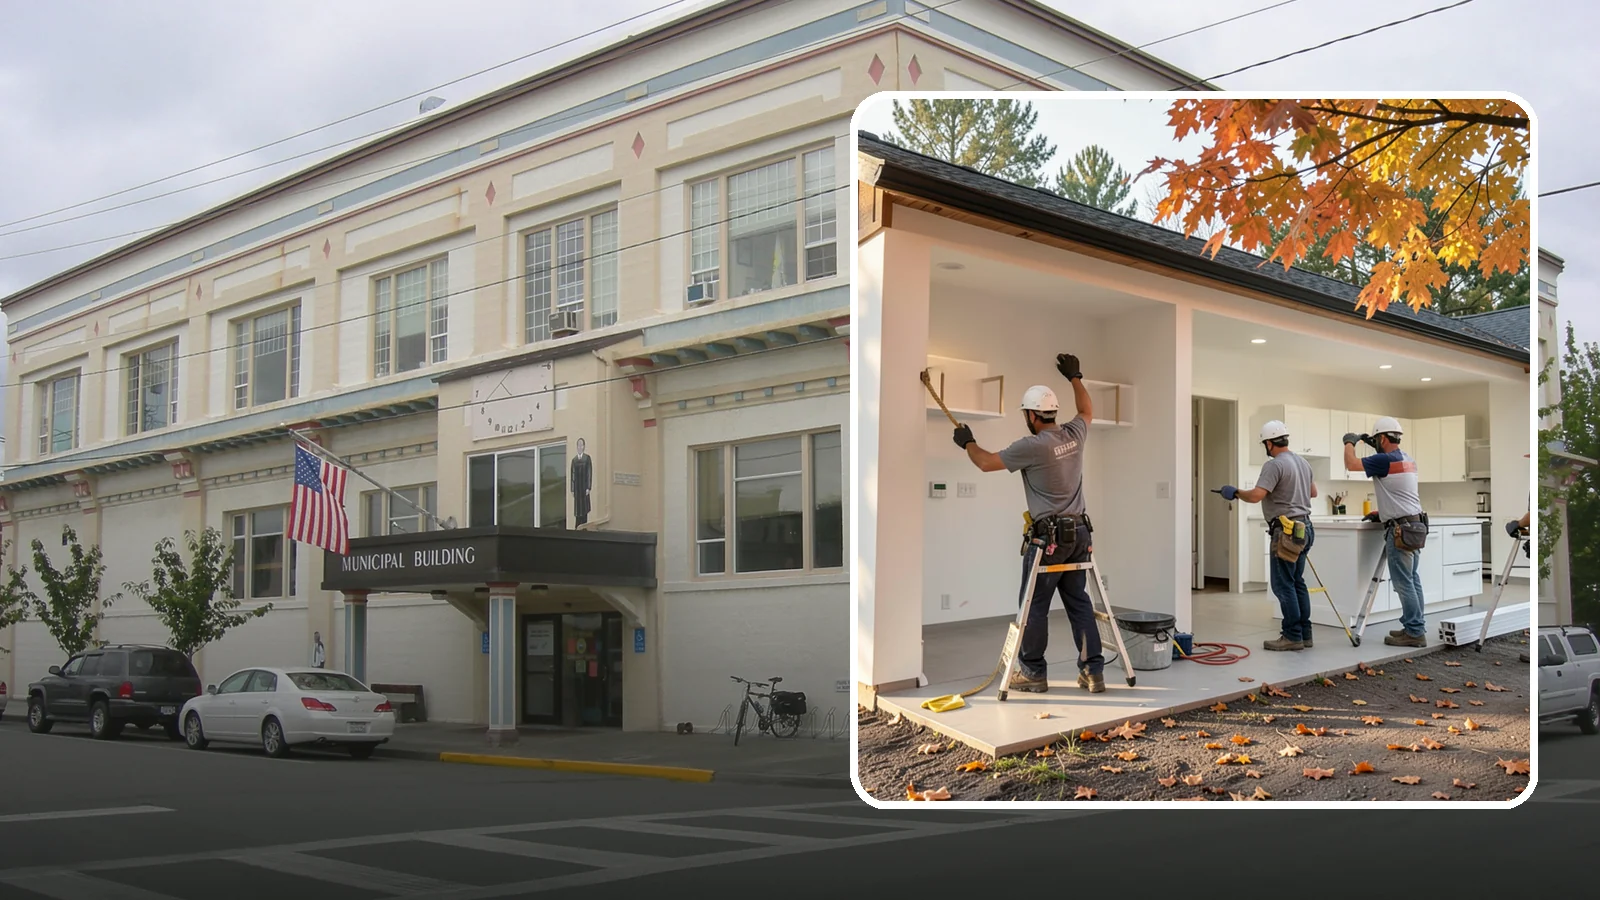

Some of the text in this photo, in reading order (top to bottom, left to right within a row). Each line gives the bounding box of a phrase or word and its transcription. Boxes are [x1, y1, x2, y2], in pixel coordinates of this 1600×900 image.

[546, 361, 552, 370] 6
[475, 390, 479, 398] 7
[536, 402, 540, 410] 4
[480, 407, 485, 415] 8
[487, 417, 492, 426] 9
[528, 414, 533, 422] 3
[494, 423, 500, 432] 10
[521, 420, 525, 428] 2
[501, 425, 506, 433] 11
[507, 425, 513, 433] 12
[342, 546, 475, 572] MUNICIPAL BUILDING
